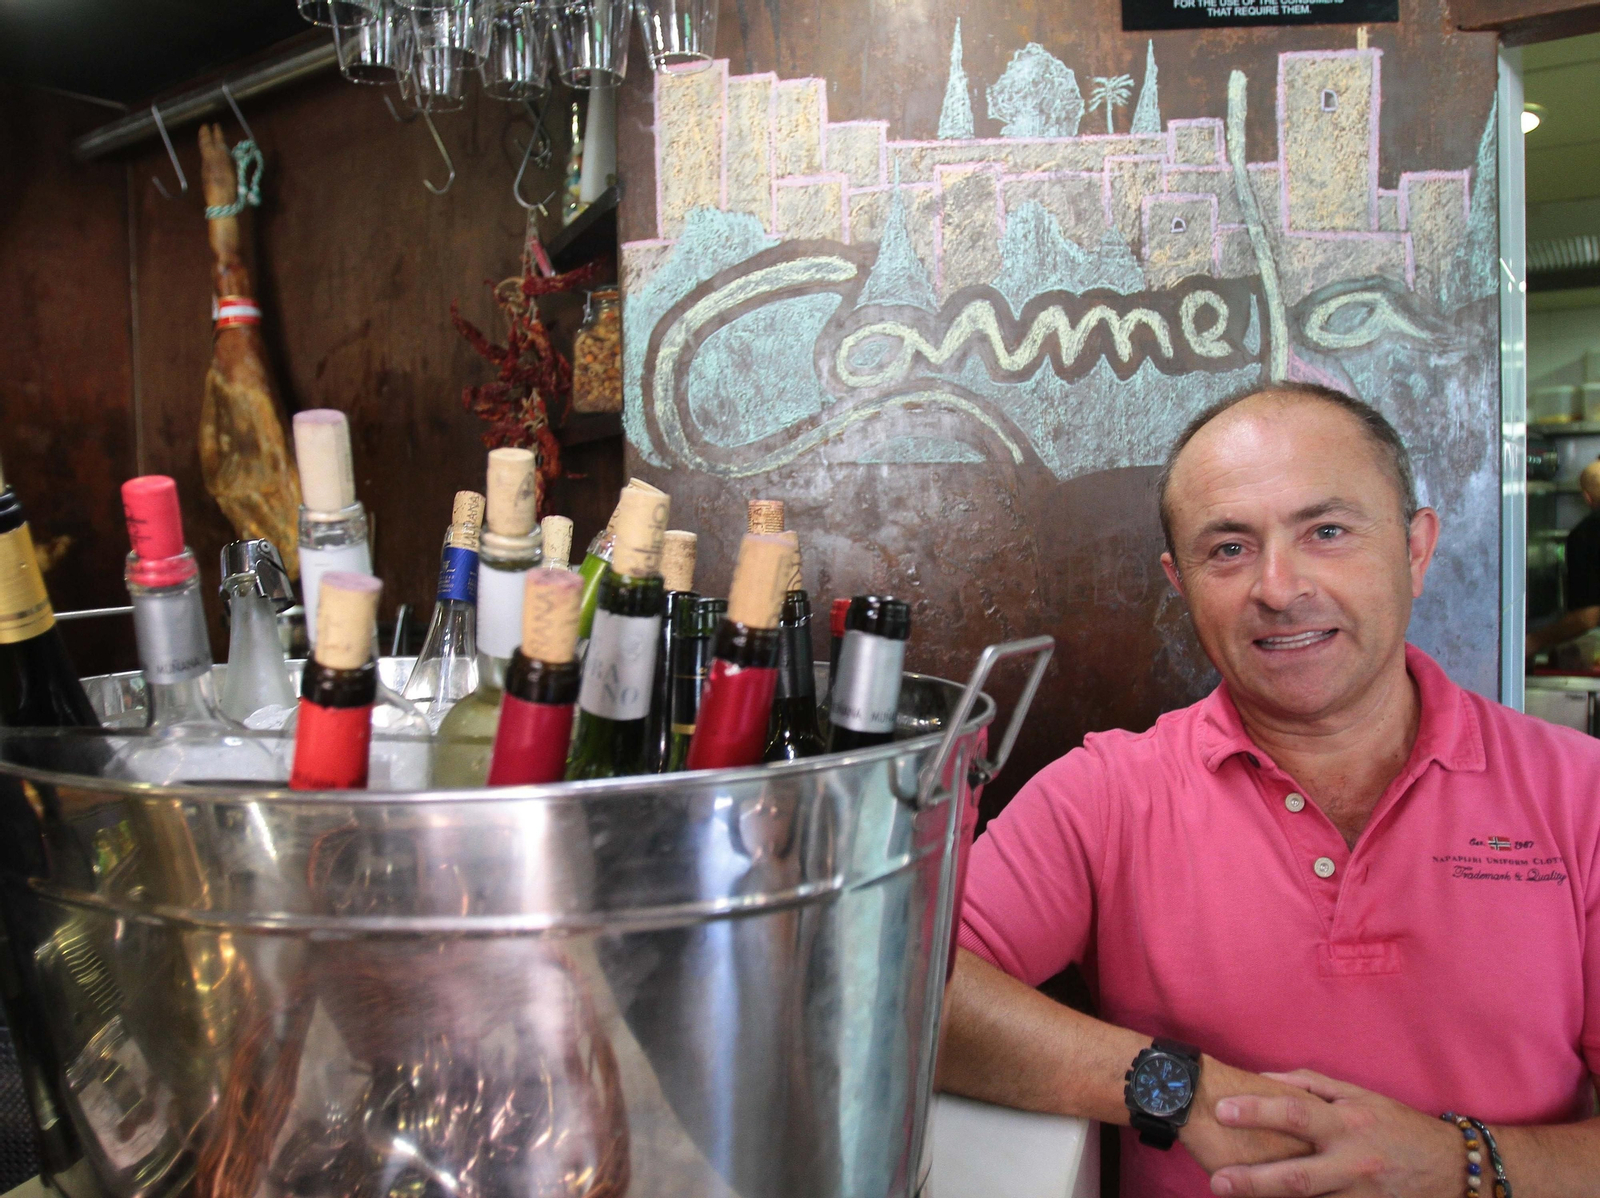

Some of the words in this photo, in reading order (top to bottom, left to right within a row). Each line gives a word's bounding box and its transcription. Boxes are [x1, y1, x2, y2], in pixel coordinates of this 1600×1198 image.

[1173, 0, 1196, 8] FOR
[1207, 7, 1233, 17] THAT
[1234, 5, 1280, 16] REQUIRE
[1281, 4, 1312, 15] THEM.
[1432, 855, 1482, 864] NAPAPIJRI
[1486, 857, 1529, 866] UNIFORM
[1452, 865, 1511, 881] Trademark
[1514, 872, 1523, 881] &
[1525, 868, 1567, 885] Quality
